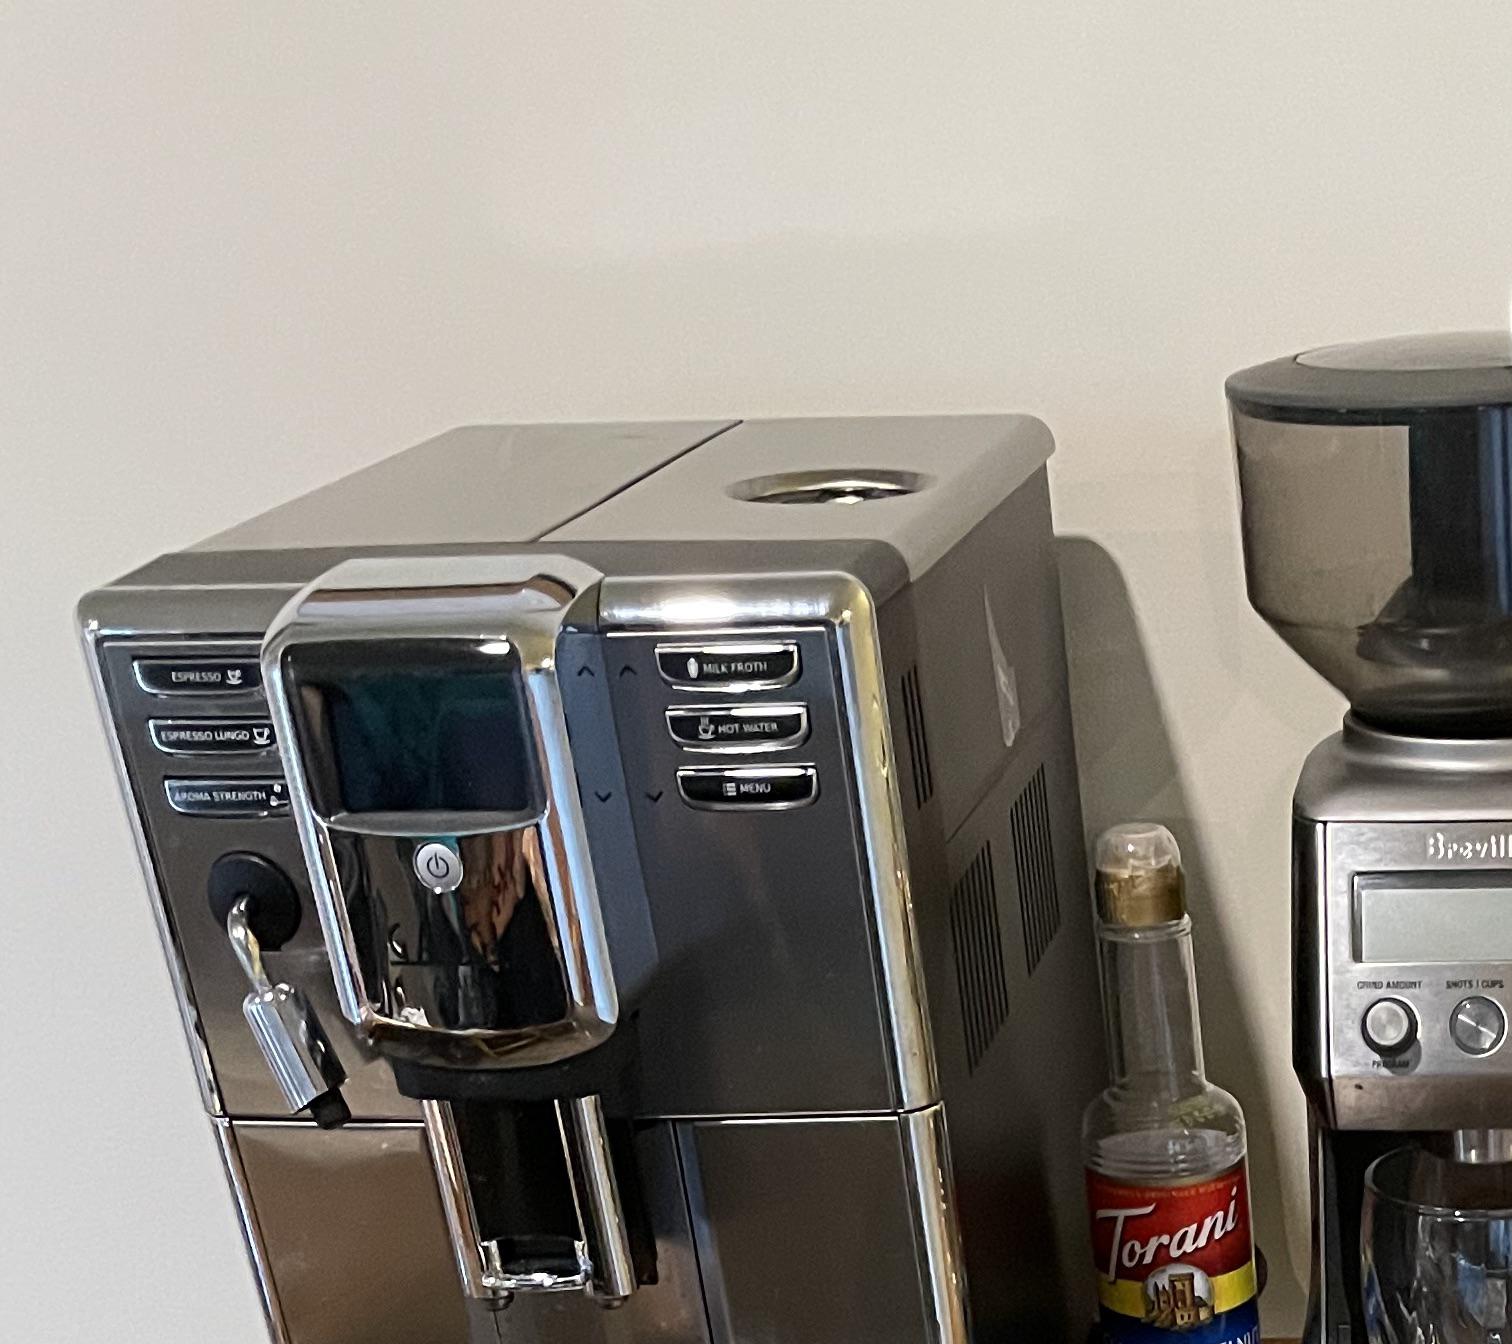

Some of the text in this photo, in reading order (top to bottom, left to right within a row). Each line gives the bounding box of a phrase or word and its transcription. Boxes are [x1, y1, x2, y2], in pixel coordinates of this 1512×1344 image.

[702, 660, 768, 675] MILK FROTH
[171, 671, 222, 683] ESPRESSO
[717, 721, 780, 735] HOT WATER
[160, 730, 250, 742] ESPRESSO LUNGO
[739, 783, 772, 795] MENU
[174, 790, 267, 802] AROMA STRENGTH
[1096, 1185, 1239, 1284] Torani
